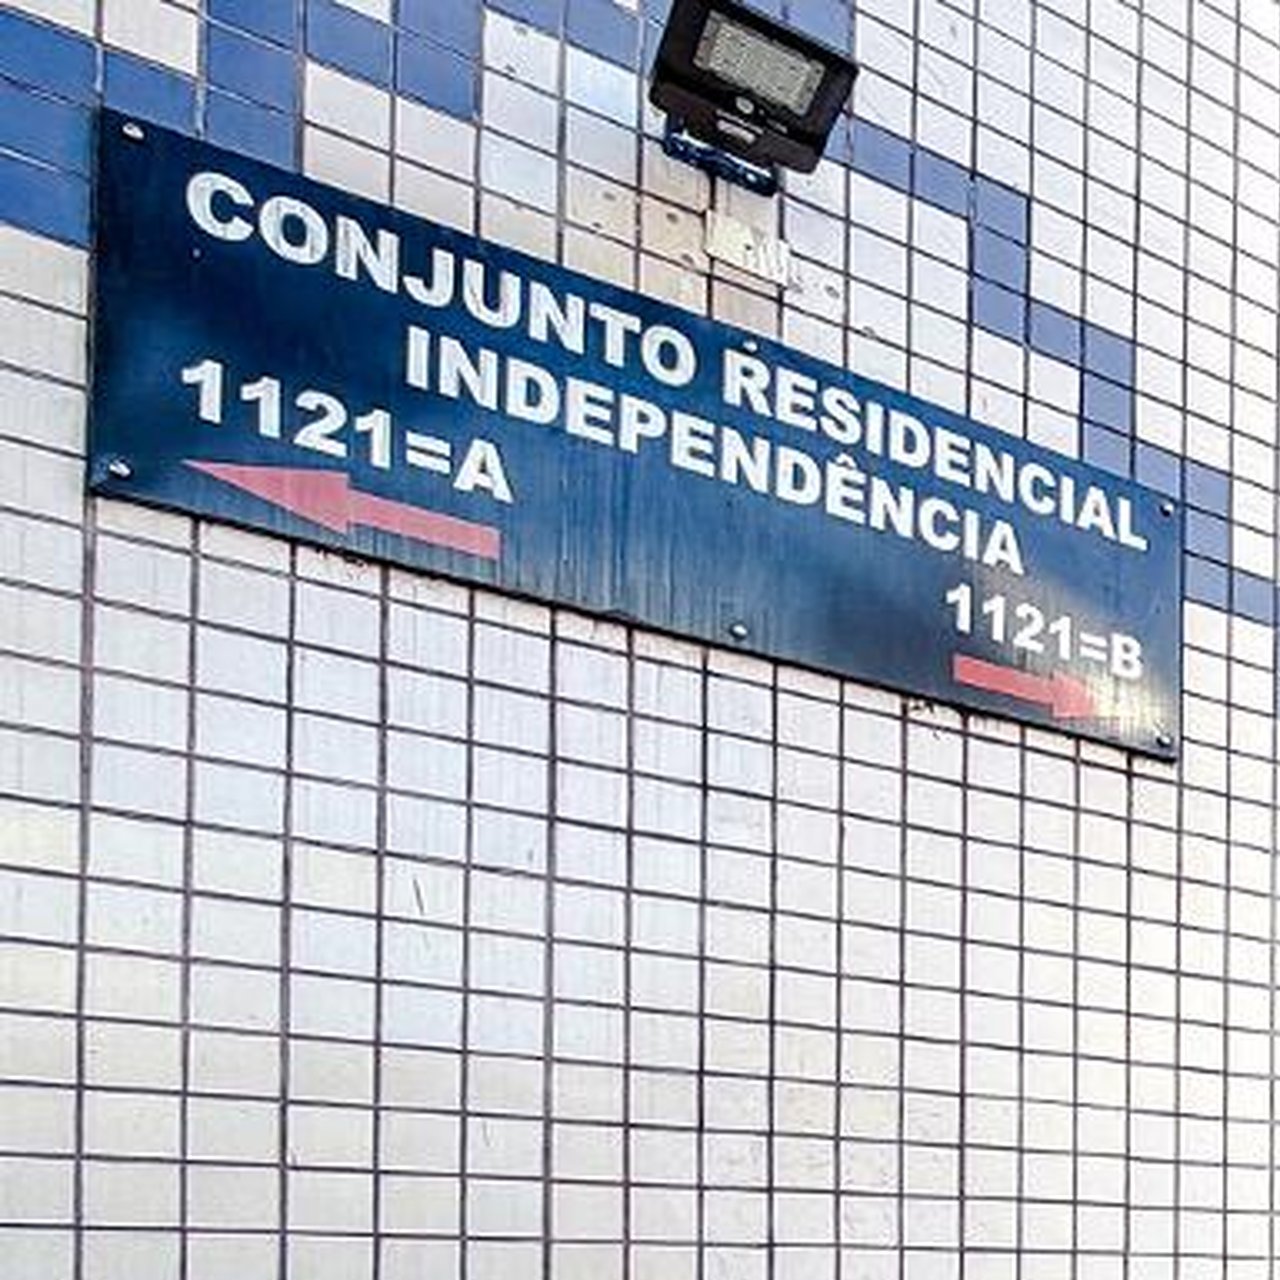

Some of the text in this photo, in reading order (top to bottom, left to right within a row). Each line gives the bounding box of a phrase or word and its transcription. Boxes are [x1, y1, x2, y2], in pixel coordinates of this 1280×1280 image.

[181, 359, 512, 502] 1121=A
[186, 172, 1149, 550] CONJUNTO RESIDENCIAL
[405, 327, 1023, 573] INDEPENDÊNCIA
[946, 586, 1143, 679] 1121=B
